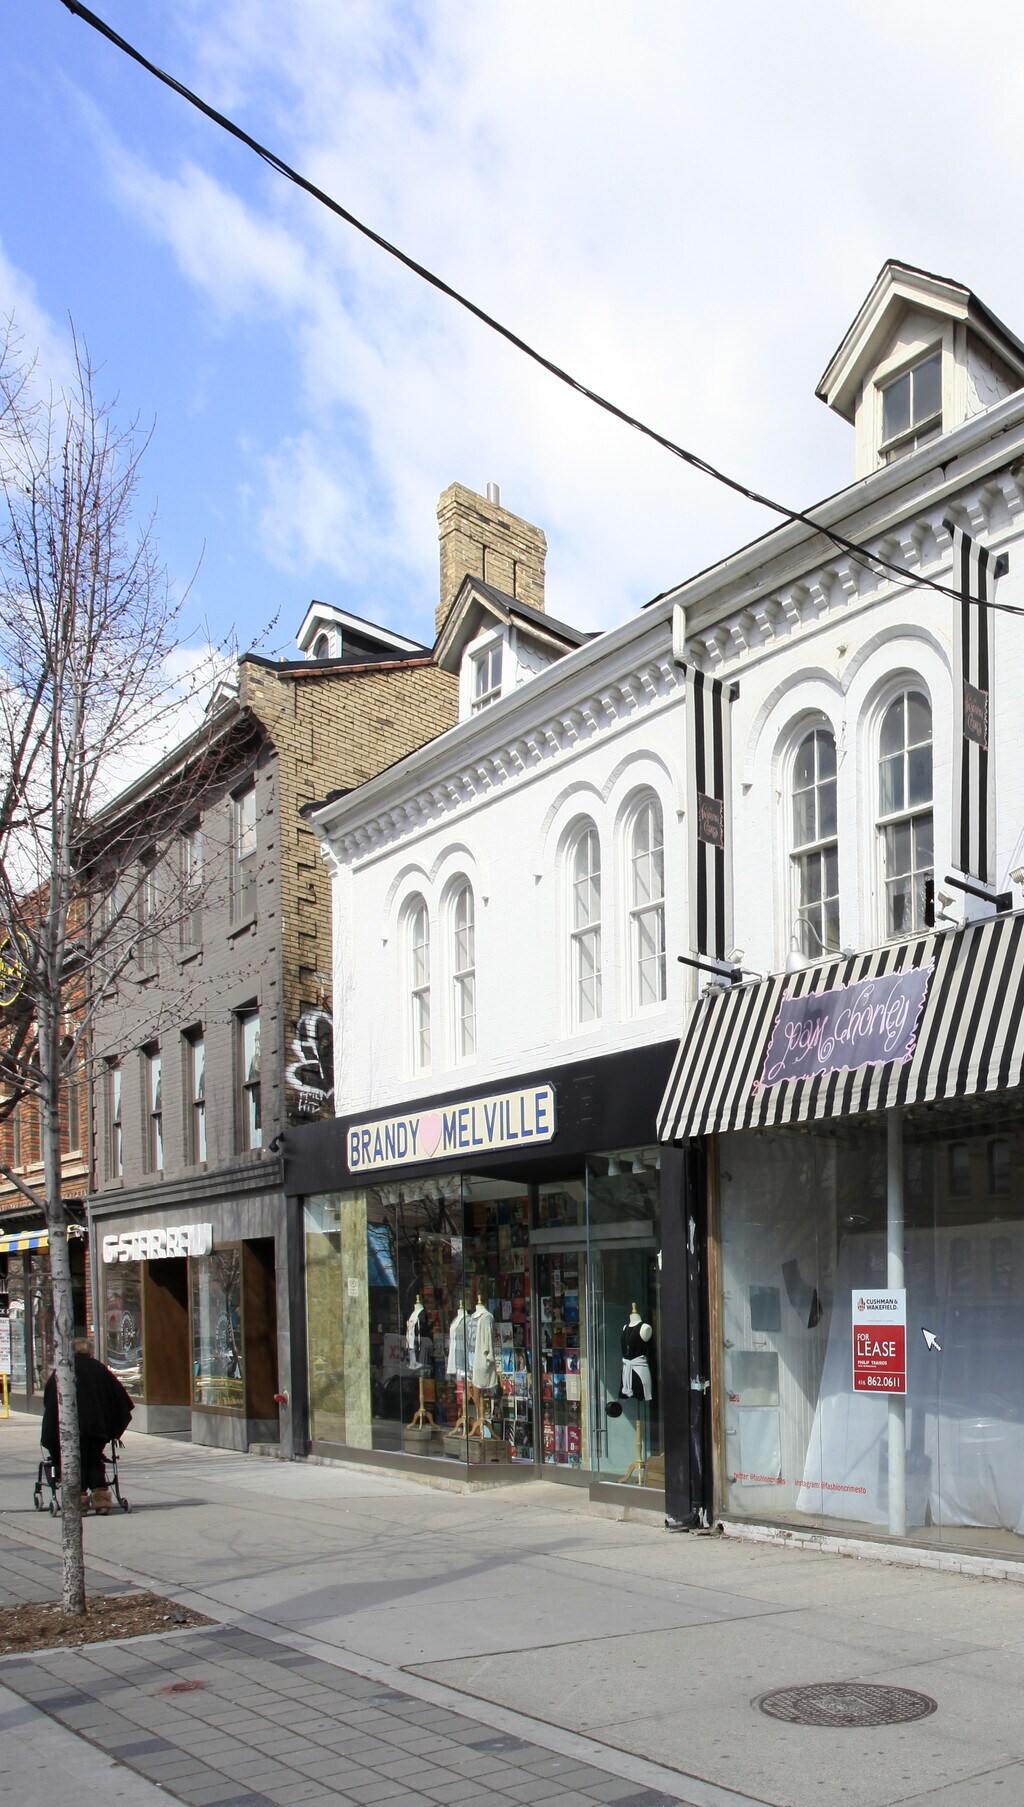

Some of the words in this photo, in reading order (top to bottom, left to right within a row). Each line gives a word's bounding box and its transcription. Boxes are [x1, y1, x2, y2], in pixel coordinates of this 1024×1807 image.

[350, 1118, 420, 1167] BRANDY
[442, 1091, 549, 1151] MELVILLE
[857, 1333, 870, 1341] FOR
[857, 1341, 896, 1357] LEASE
[867, 1375, 900, 1388] 862.0611
